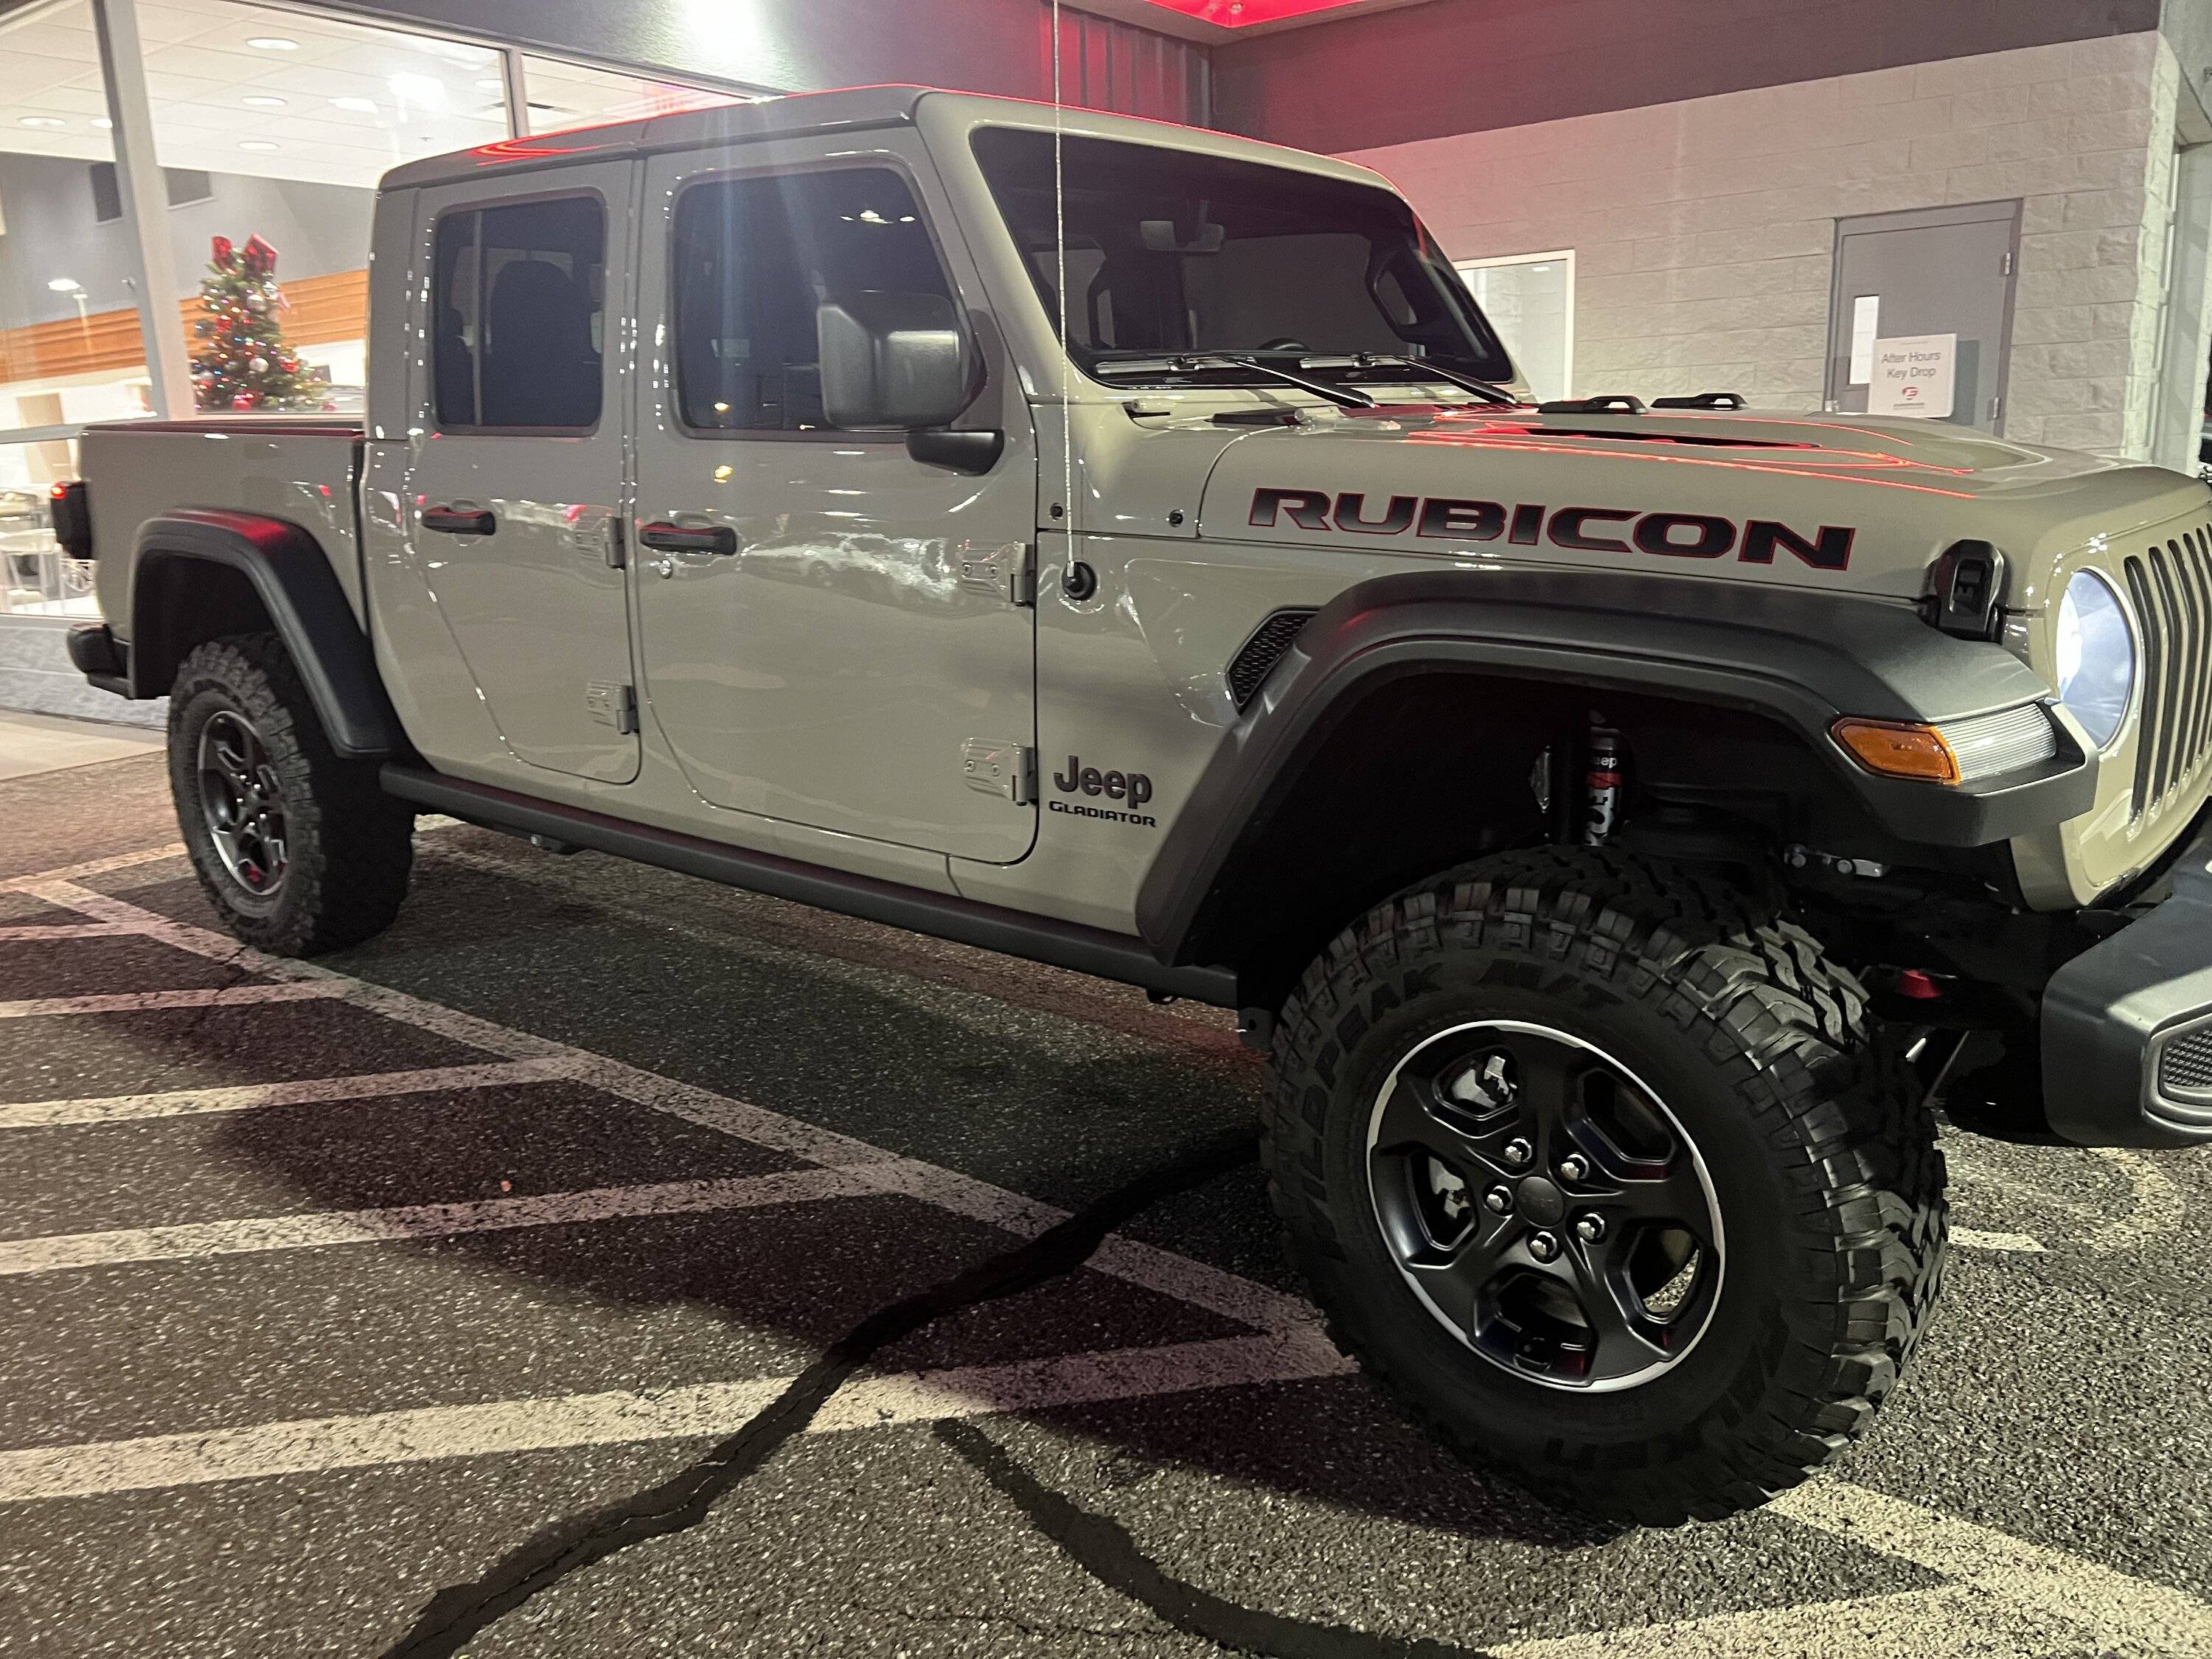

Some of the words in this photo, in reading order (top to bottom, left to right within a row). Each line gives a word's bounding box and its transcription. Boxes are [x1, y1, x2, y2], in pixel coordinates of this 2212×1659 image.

[1881, 352, 1907, 364] After
[1908, 352, 1941, 362] Hours
[1886, 368, 1907, 380] Key
[1910, 366, 1936, 378] Drop
[1248, 487, 1856, 571] RUBICON
[1054, 755, 1152, 810] Jeep
[1048, 800, 1156, 828] GLADIATOR
